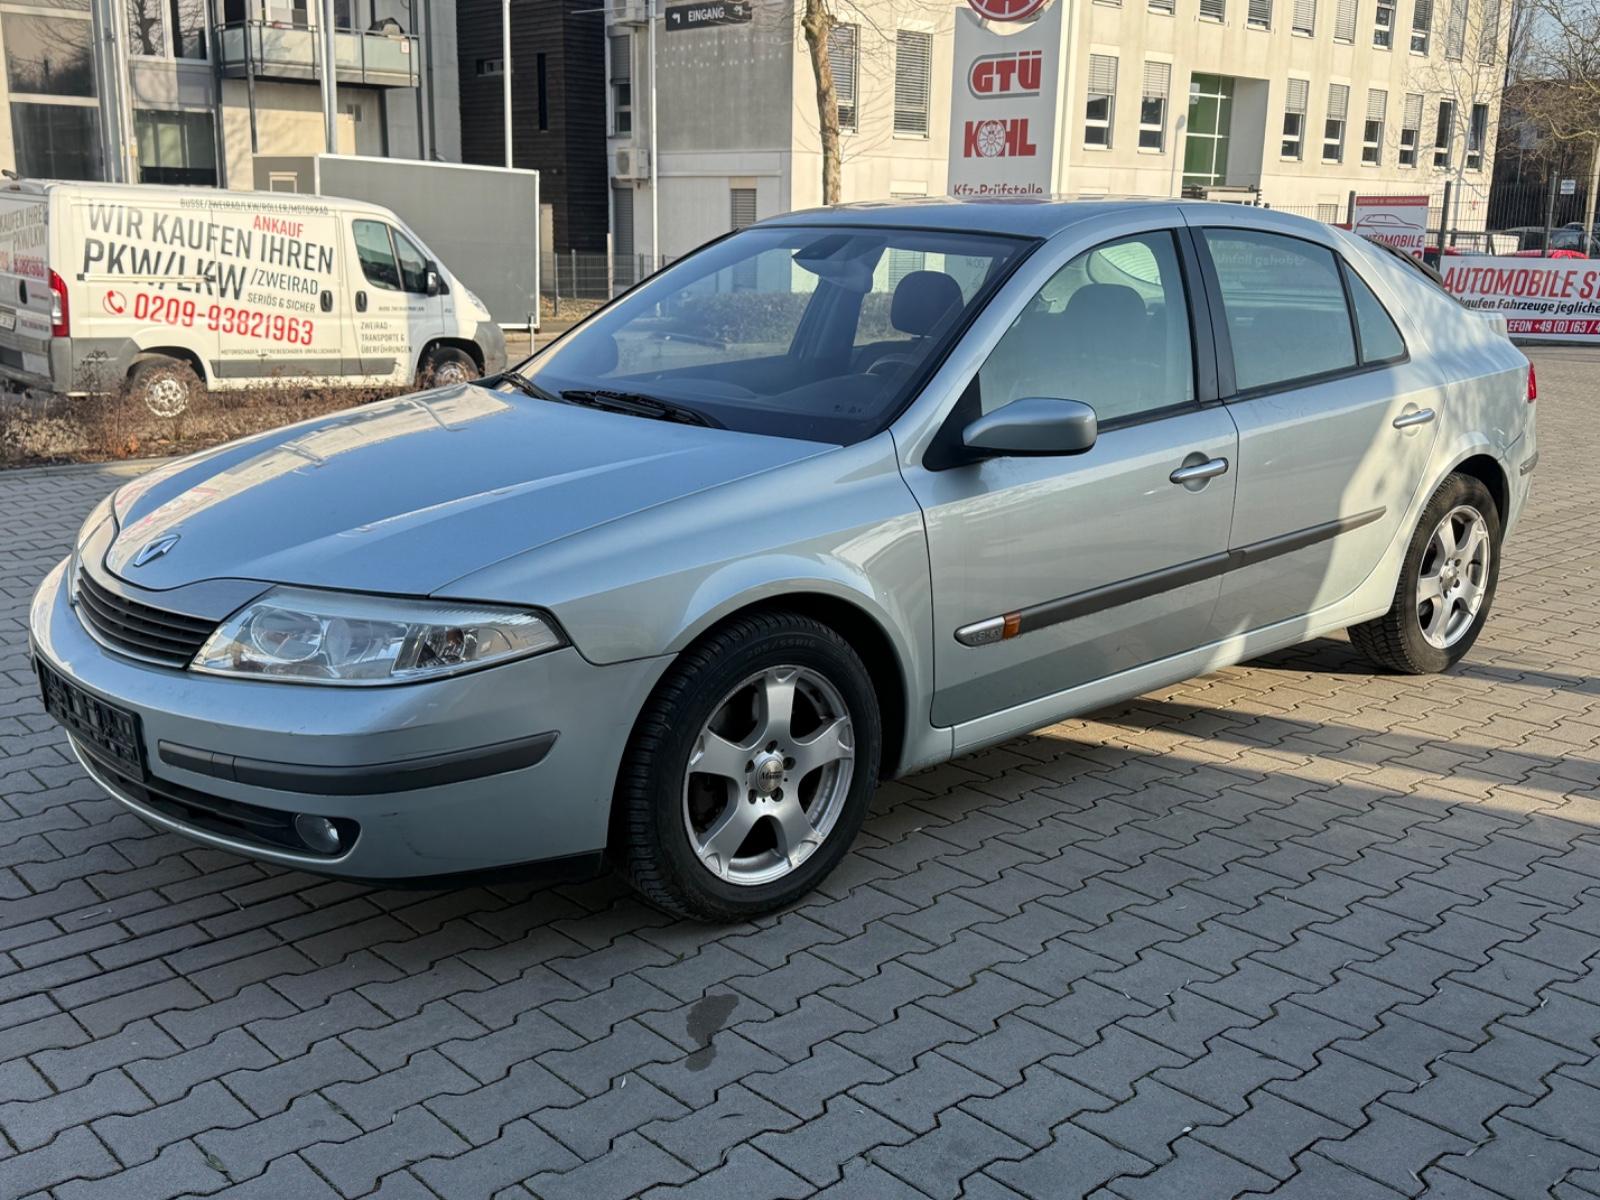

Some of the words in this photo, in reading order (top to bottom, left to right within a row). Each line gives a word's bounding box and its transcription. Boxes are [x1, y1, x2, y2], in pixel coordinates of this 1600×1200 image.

[688, 7, 725, 22] EINGANG
[972, 50, 1042, 93] GTÜ
[964, 119, 1037, 158] KOHL
[88, 204, 143, 240] WIR
[152, 212, 252, 260] KAUFEN
[260, 233, 333, 275] IHREN
[253, 214, 304, 238] ANKAUF
[1365, 233, 1424, 247] TOMOBILE
[83, 238, 247, 301] PKW/LKW
[250, 268, 318, 296] /ZWEIRAD
[1443, 266, 1578, 298] AUTOMOBILE
[1579, 270, 1600, 299] S
[247, 292, 278, 307] SERIÖS
[286, 299, 316, 313] SICHER
[1497, 299, 1554, 313] Fahrzeuge
[134, 292, 314, 346] 0209-93821963
[1534, 320, 1552, 332] +49
